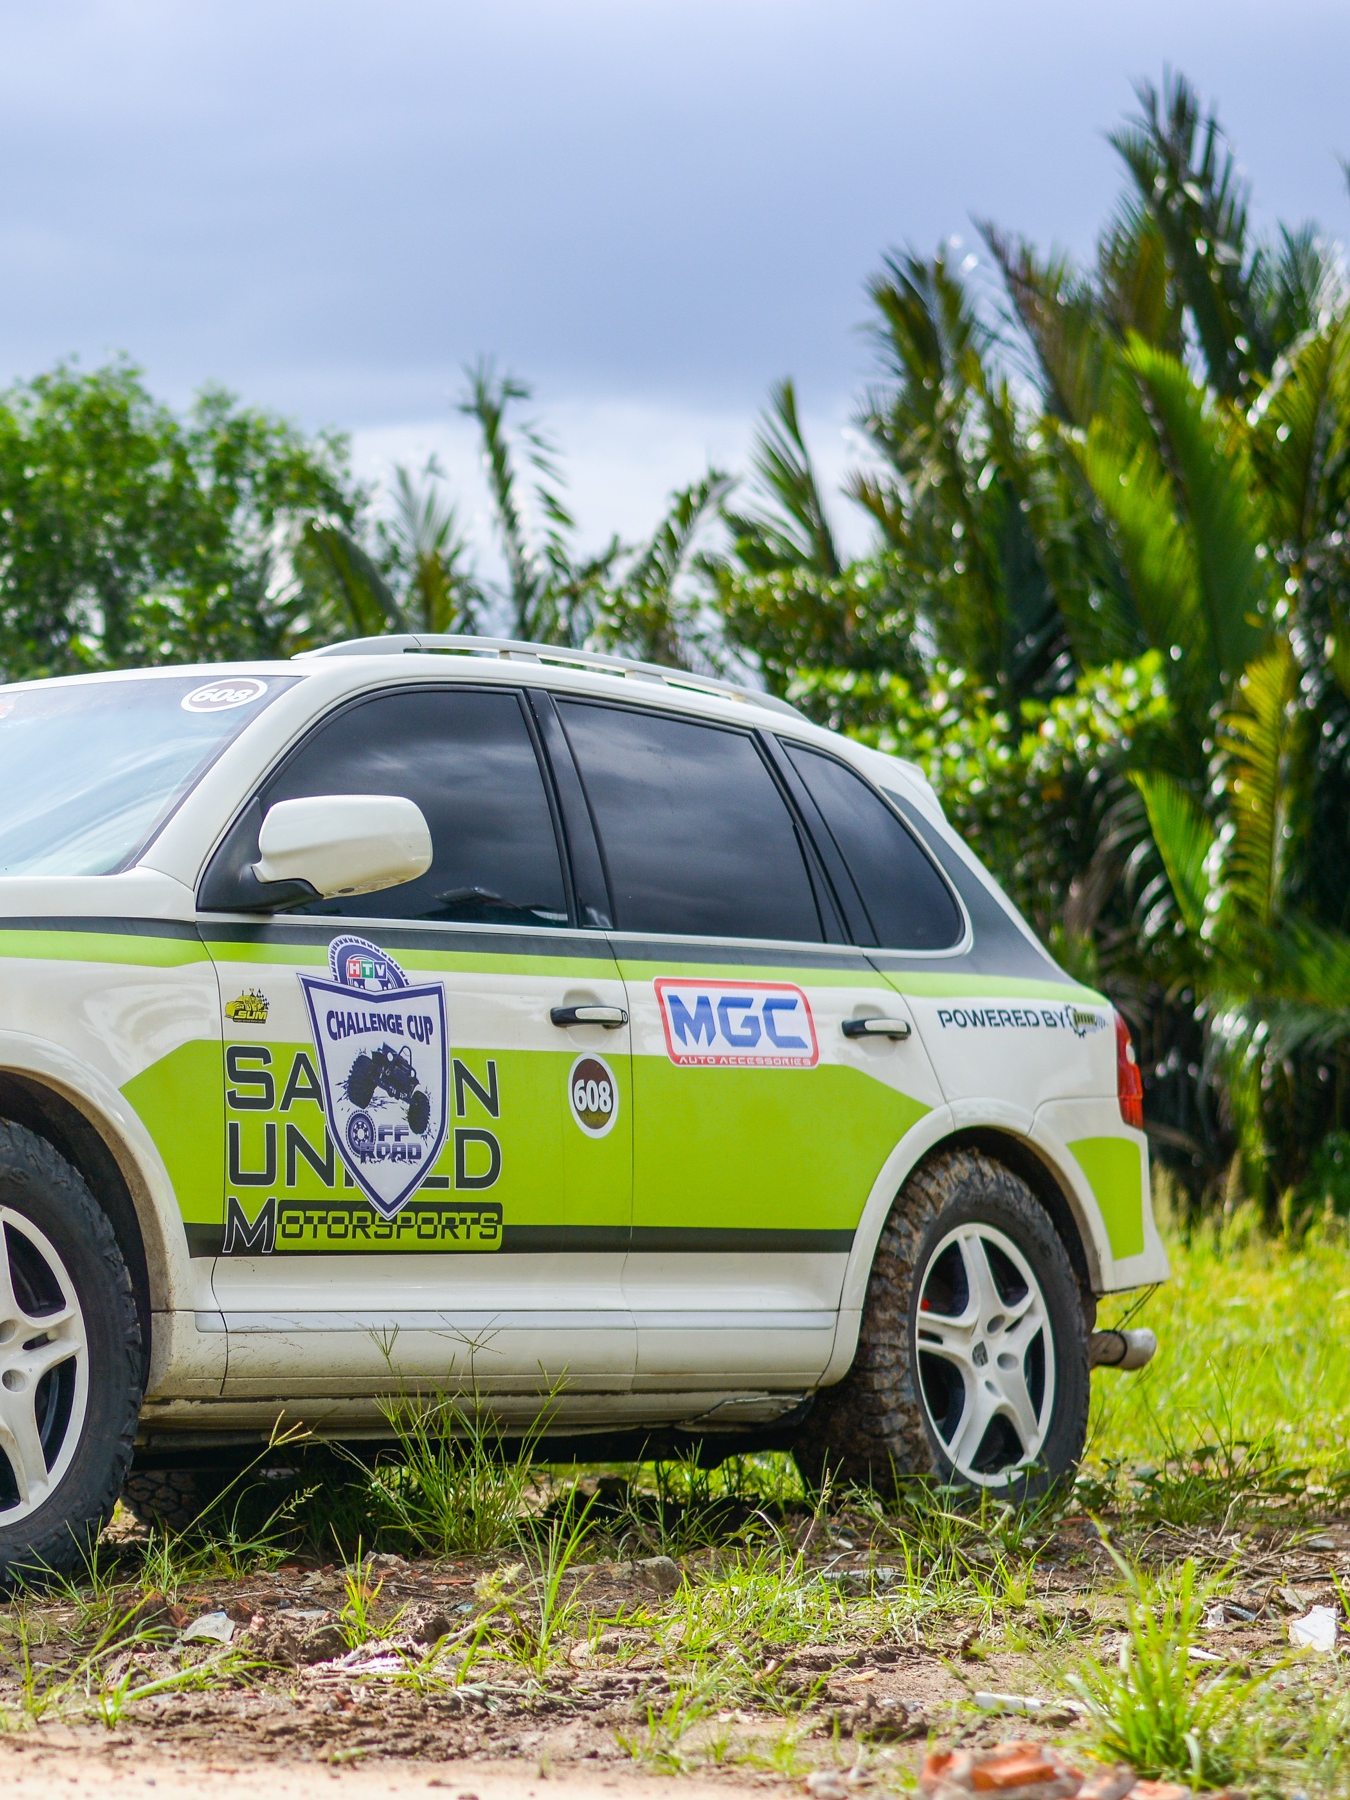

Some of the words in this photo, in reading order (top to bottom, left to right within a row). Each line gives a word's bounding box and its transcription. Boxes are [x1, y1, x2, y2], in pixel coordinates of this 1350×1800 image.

[191, 688, 254, 702] 608
[348, 960, 387, 979] HTV
[326, 1010, 404, 1041] CHALLENGE
[407, 1015, 433, 1045] CUP
[667, 995, 808, 1048] MGC
[937, 1009, 1040, 1028] POWERED
[1040, 1011, 1066, 1028] BY
[720, 1057, 811, 1066] ACCESSORIES
[226, 1045, 500, 1118] SAN
[574, 1079, 612, 1113] 608
[228, 1121, 502, 1190] UND
[359, 1142, 421, 1164] ROAD
